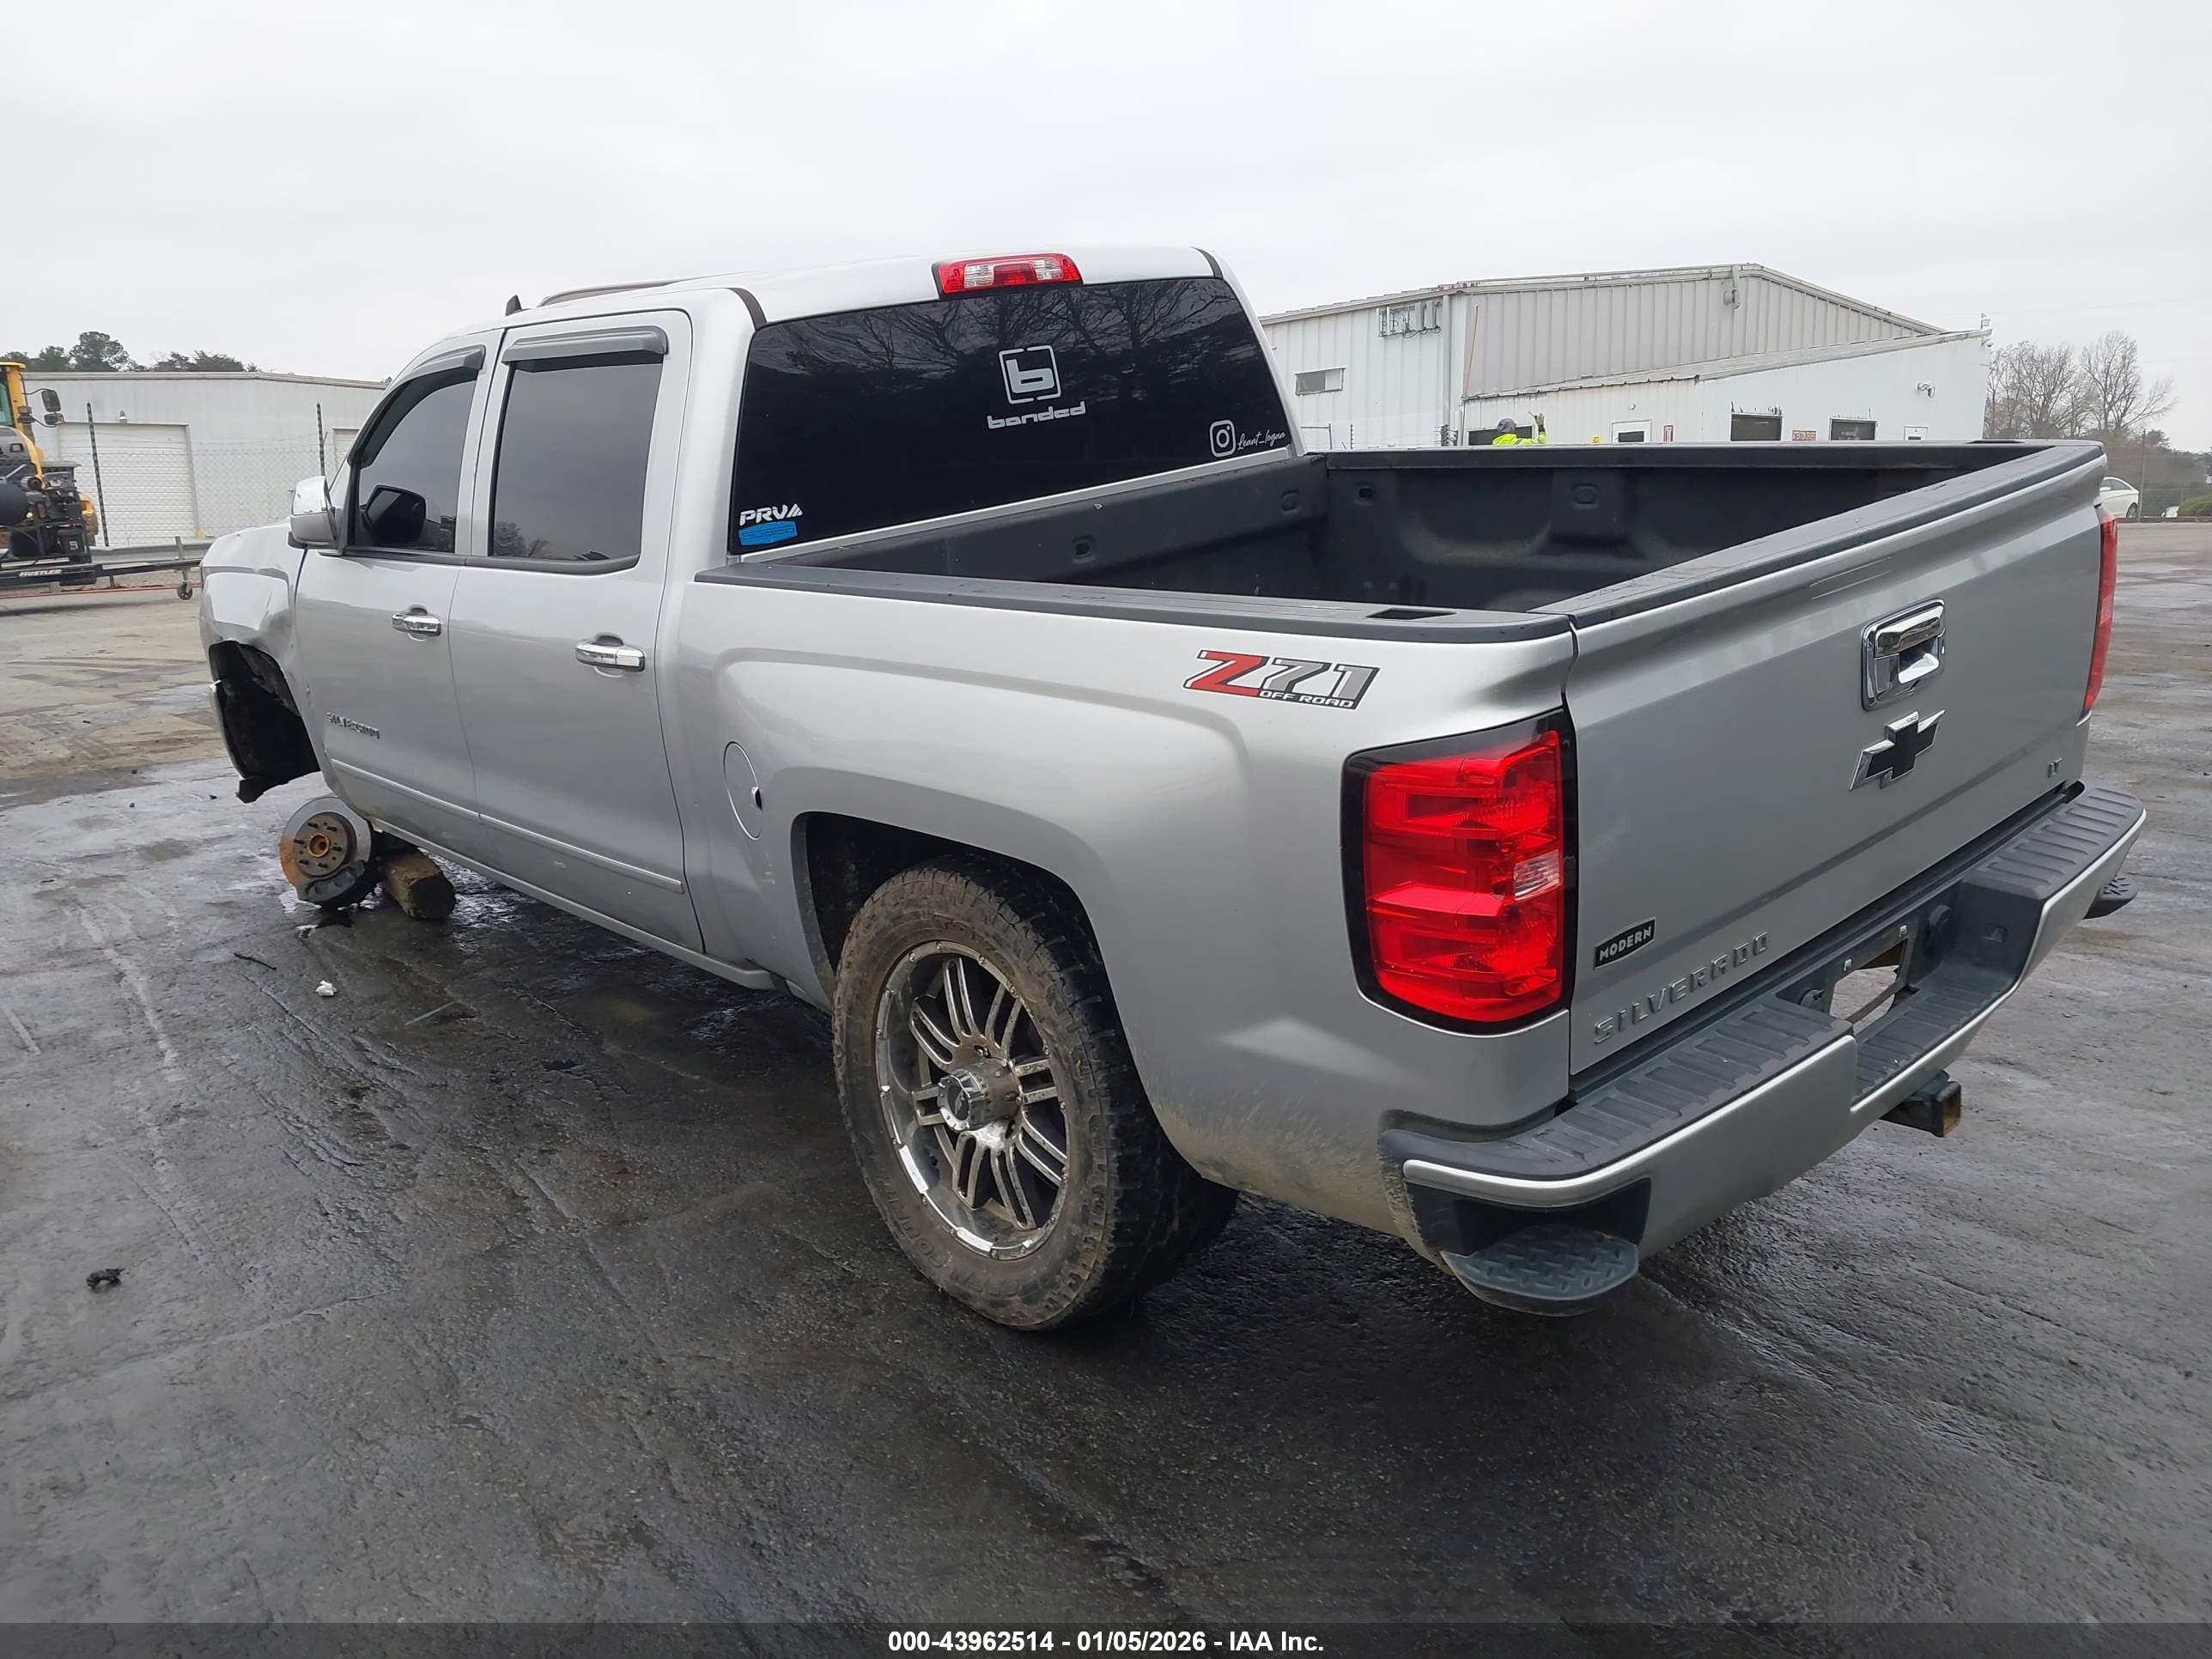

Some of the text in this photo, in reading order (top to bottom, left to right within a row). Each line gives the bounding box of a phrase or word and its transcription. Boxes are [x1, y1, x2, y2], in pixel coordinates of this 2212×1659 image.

[987, 400, 1086, 429] banded
[1182, 649, 1381, 706] Z71
[1259, 690, 1354, 708] OFF ROAD
[1600, 927, 1651, 961] MODERN
[1594, 932, 1769, 1044] SILVERADO
